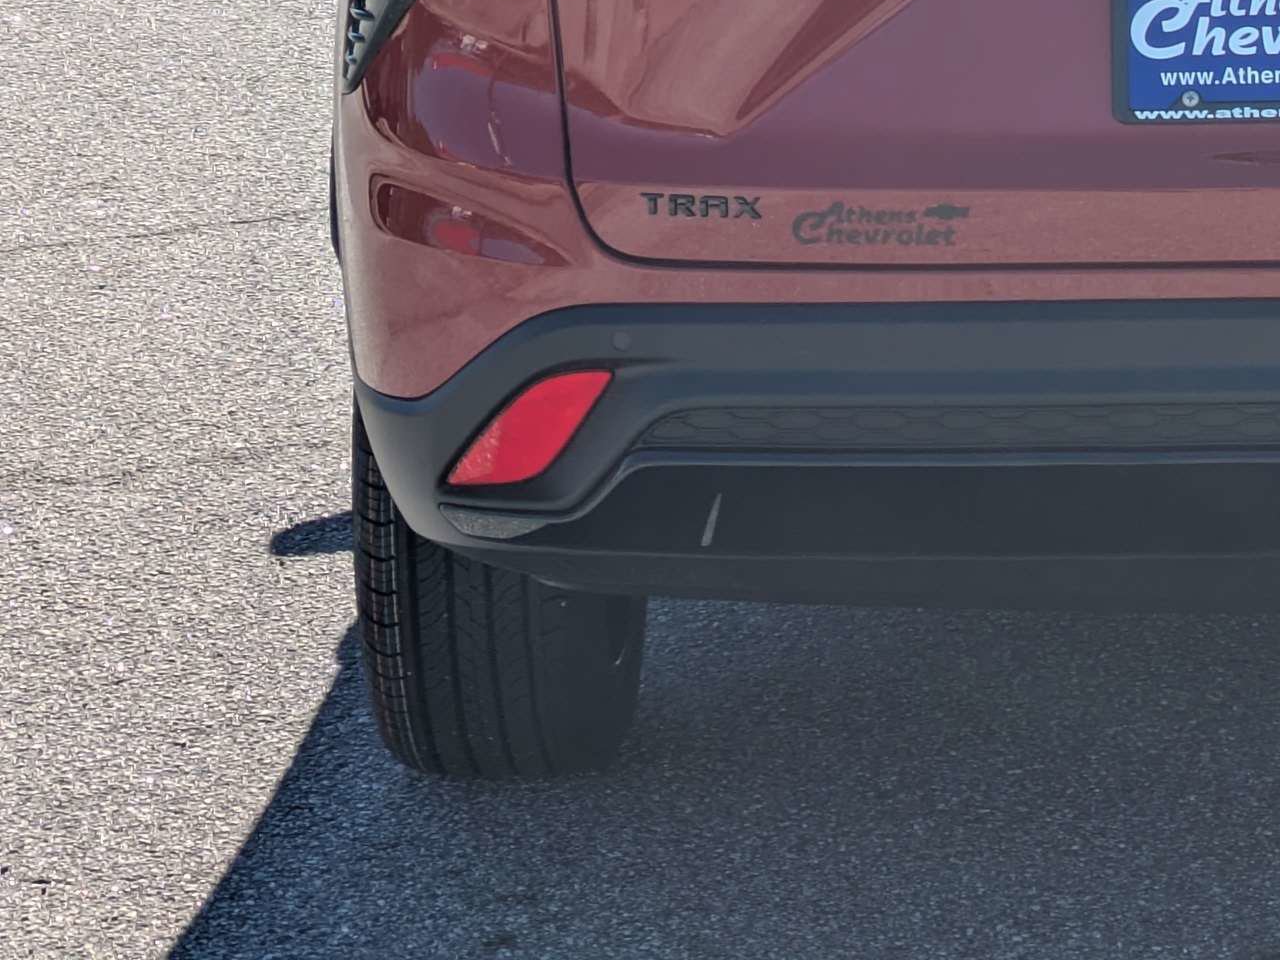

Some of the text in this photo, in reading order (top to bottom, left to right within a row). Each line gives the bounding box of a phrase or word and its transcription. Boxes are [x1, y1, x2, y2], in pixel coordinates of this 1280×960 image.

[641, 192, 762, 220] TRAX
[820, 201, 918, 225] Athens
[792, 211, 957, 246] Chevrolet
